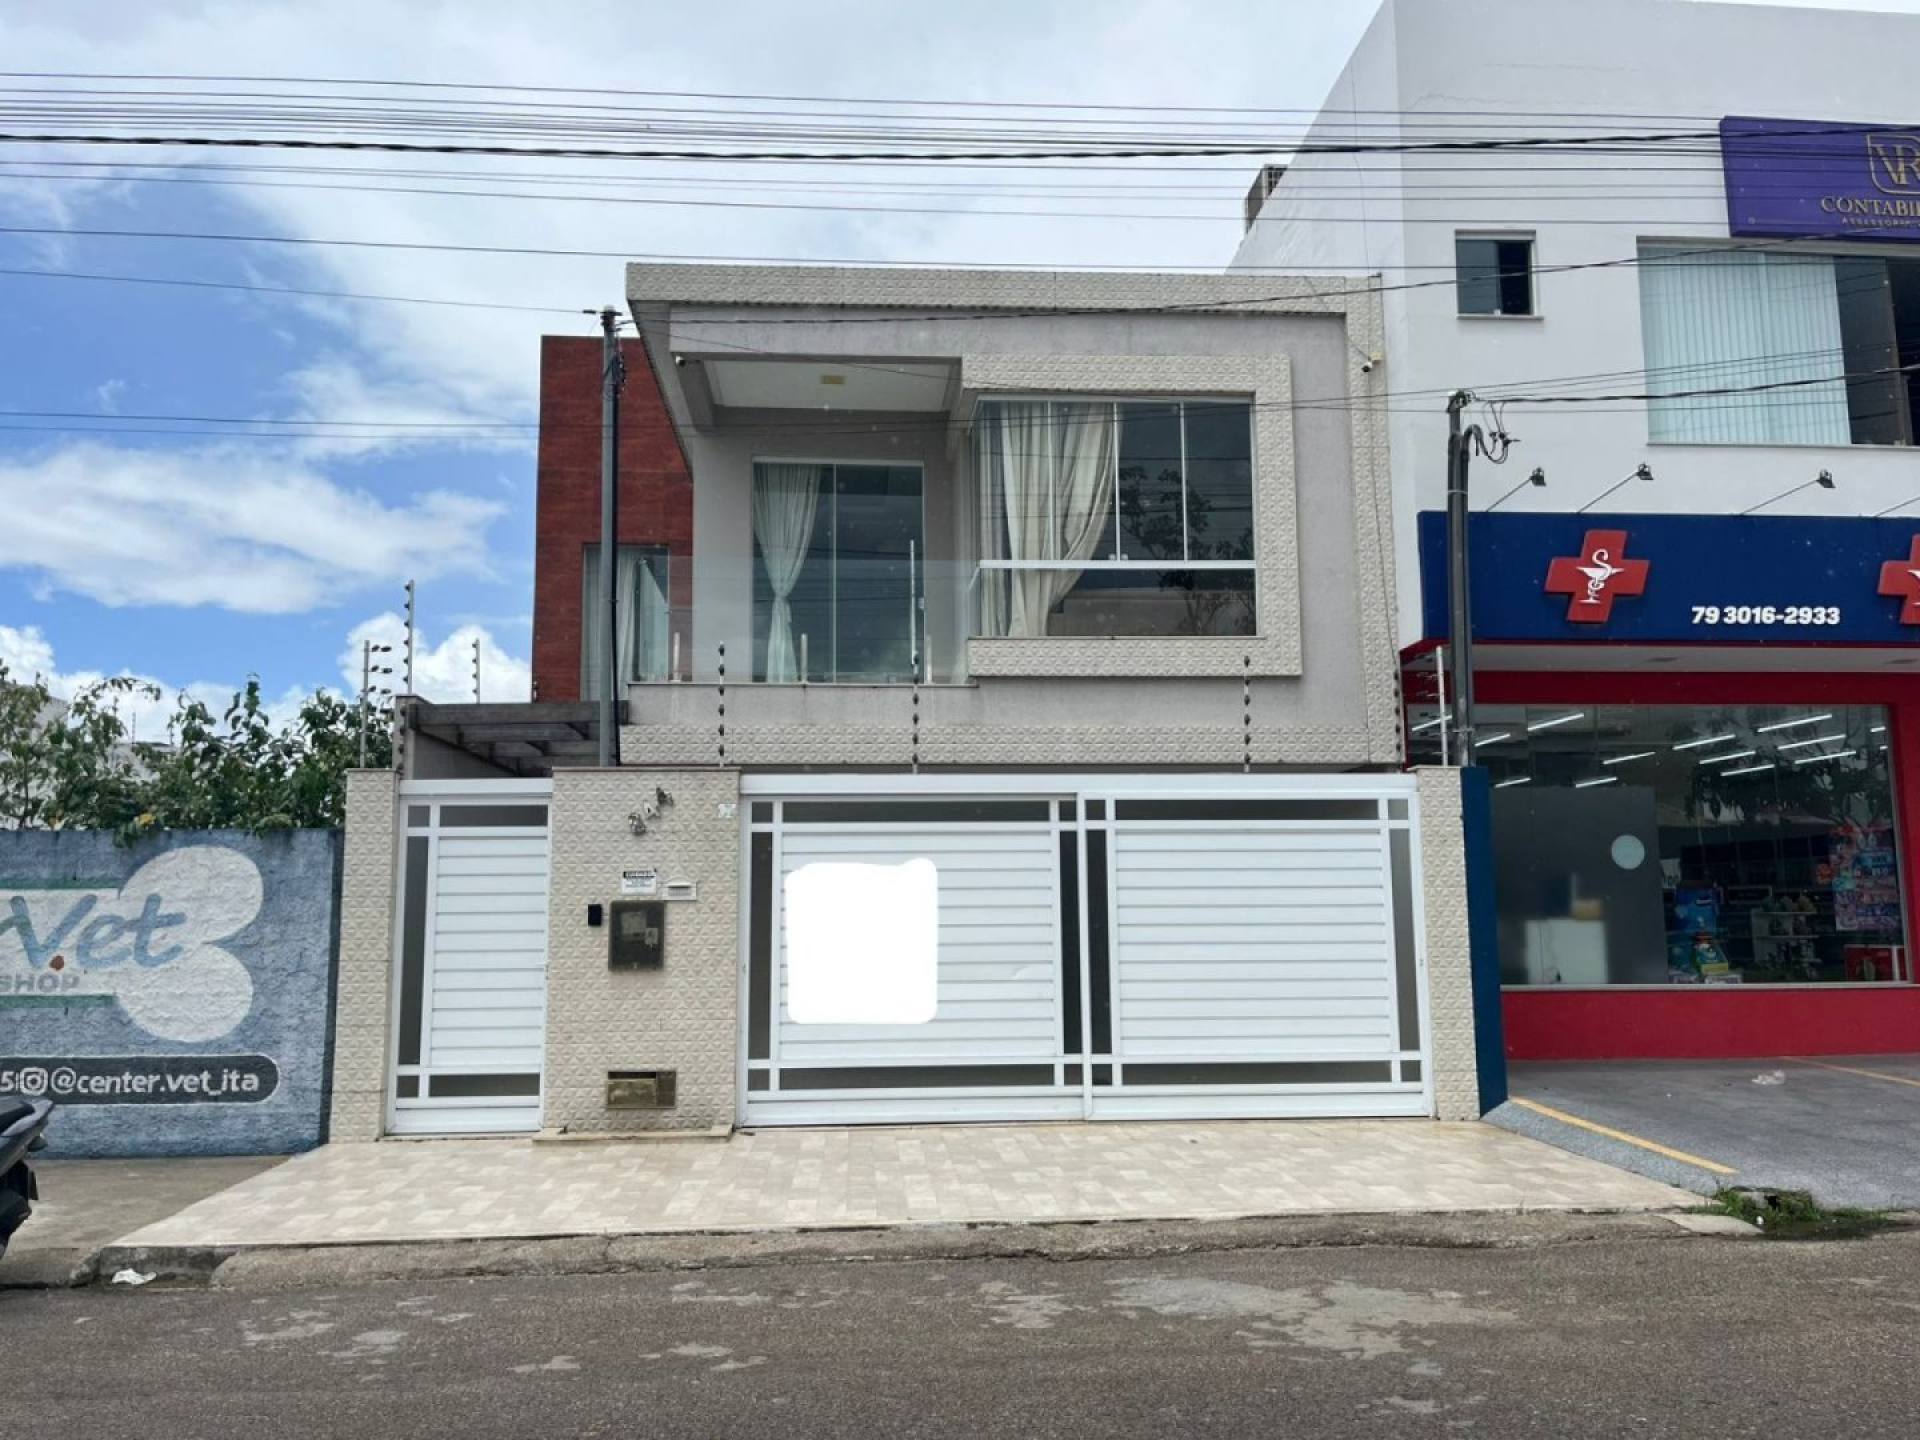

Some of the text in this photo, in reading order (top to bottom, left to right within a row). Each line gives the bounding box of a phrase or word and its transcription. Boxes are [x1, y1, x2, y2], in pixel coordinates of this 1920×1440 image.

[1691, 606, 1841, 625] 79 3016-2933
[51, 1066, 259, 1096] @center.vet_ita
